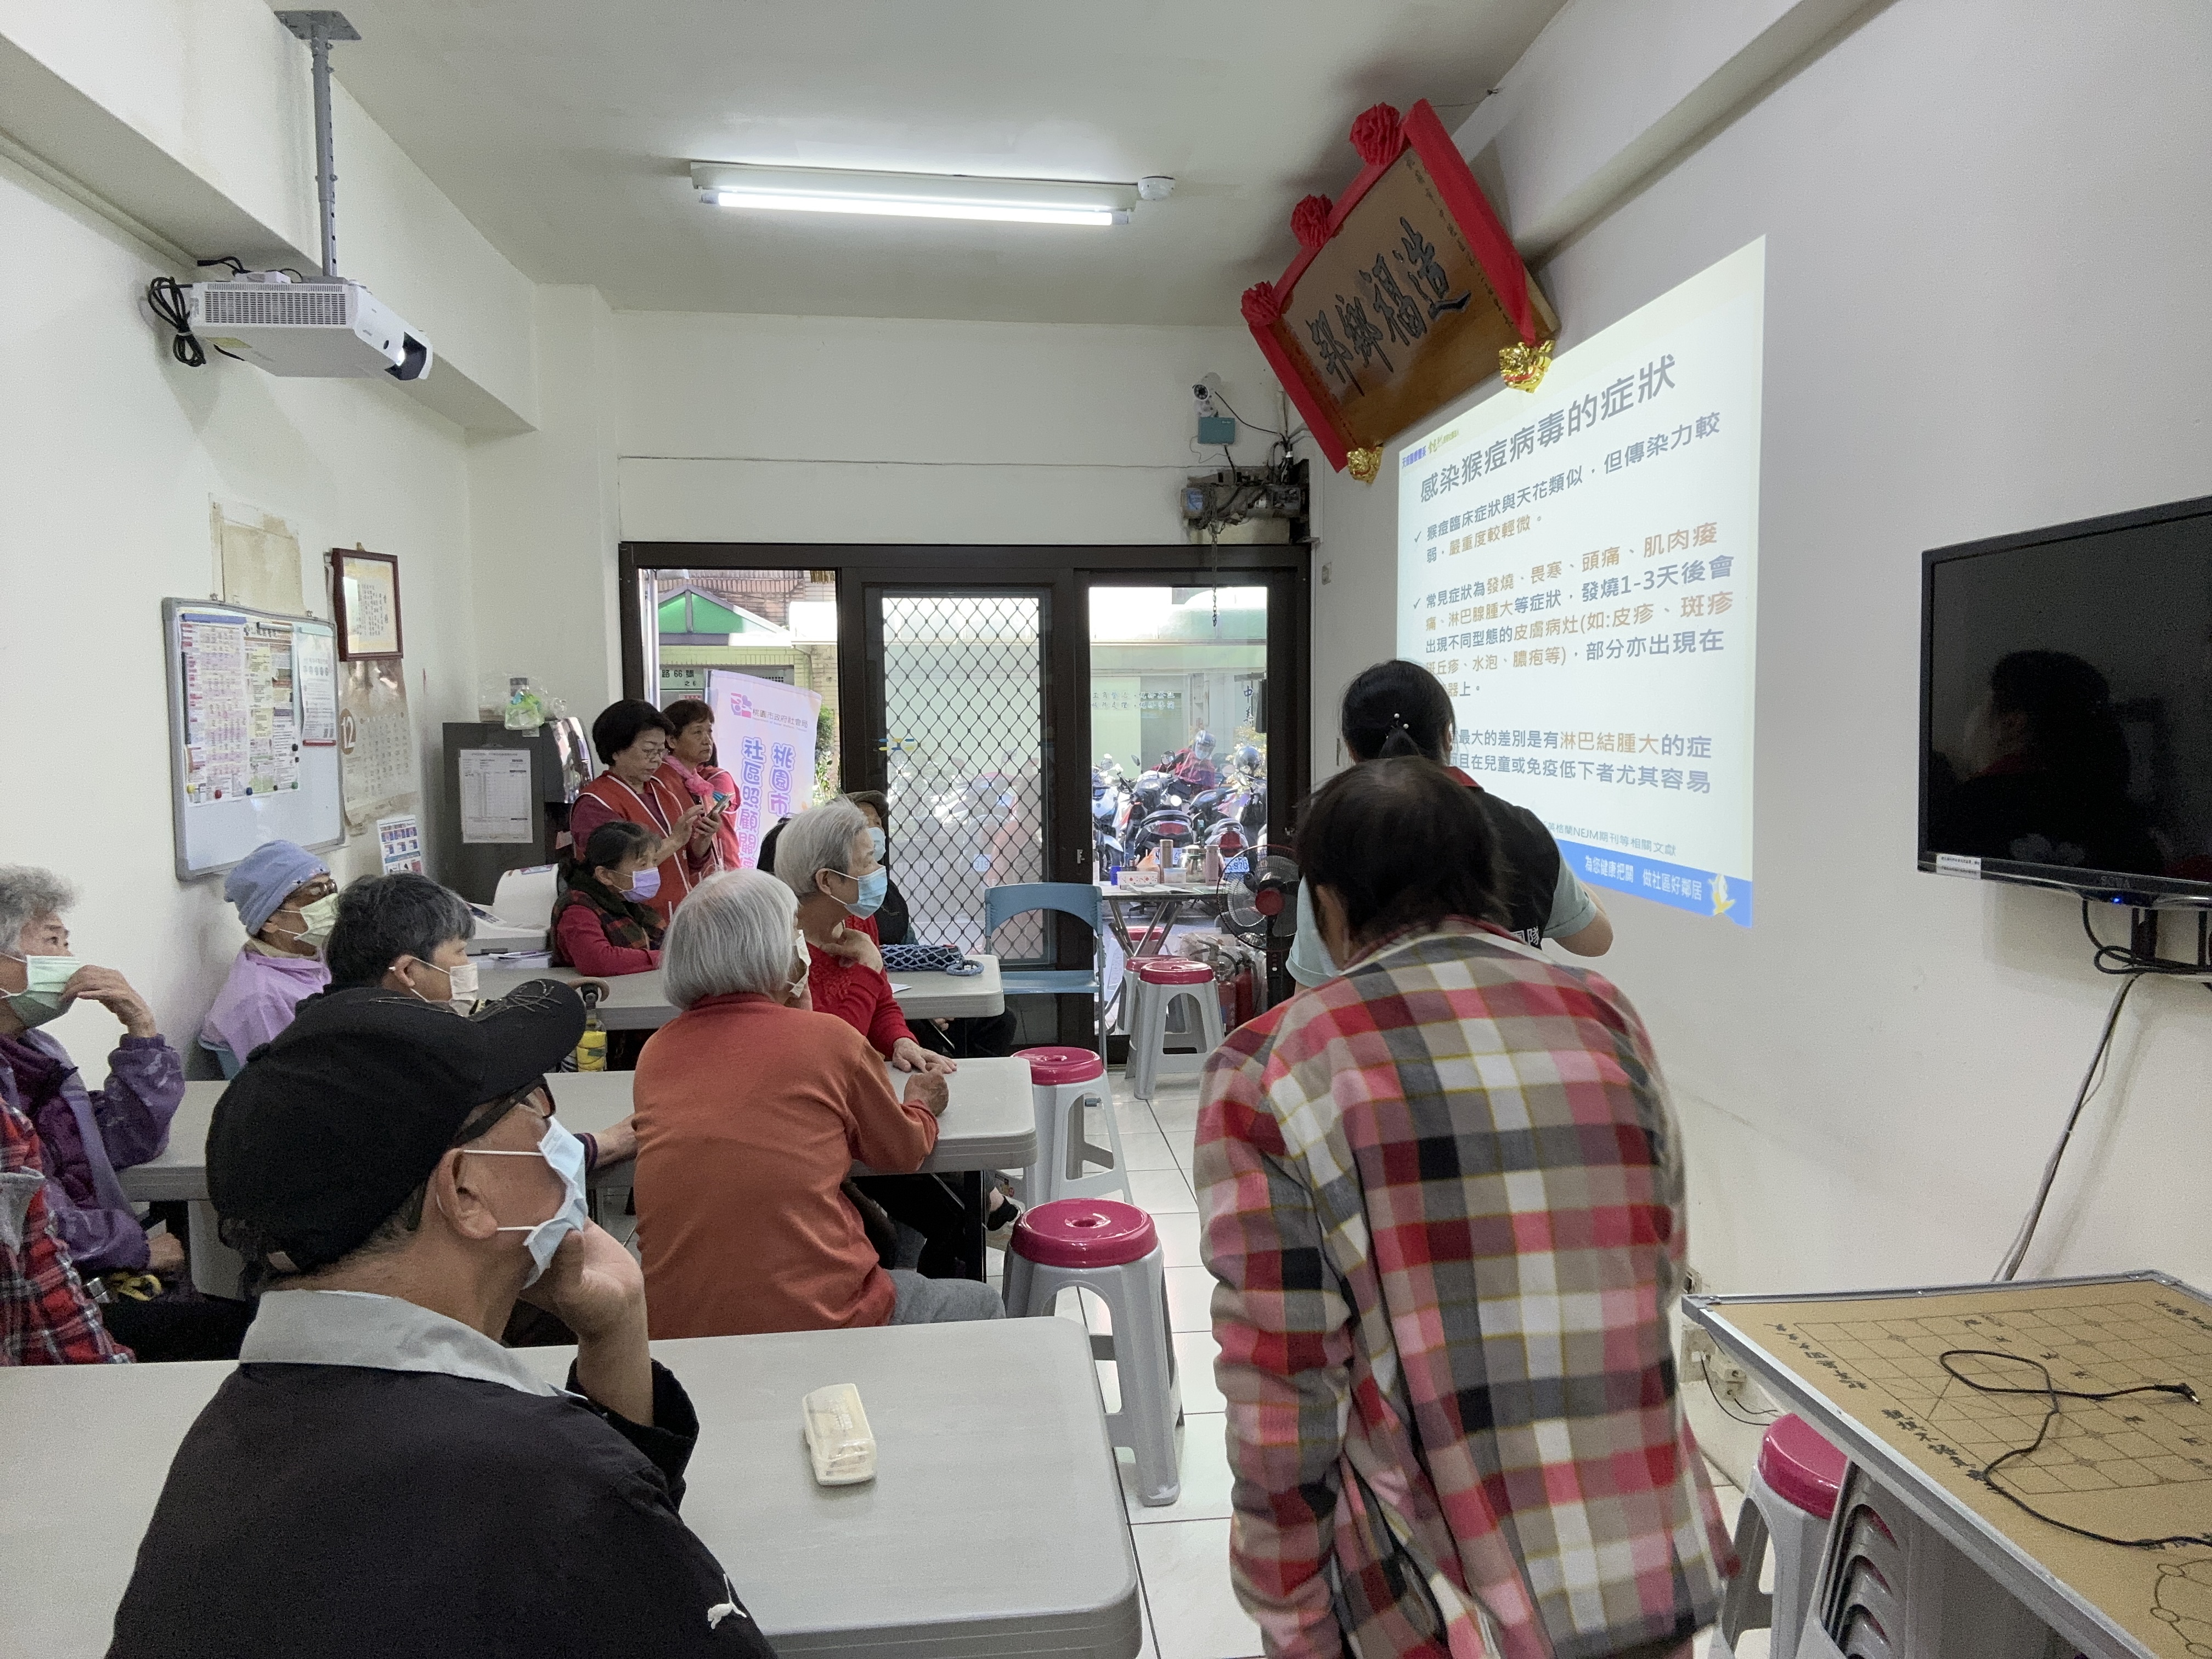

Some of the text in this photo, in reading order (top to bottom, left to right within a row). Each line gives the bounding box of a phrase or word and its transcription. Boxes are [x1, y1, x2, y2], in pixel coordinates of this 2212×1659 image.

[1420, 353, 1676, 503] 感染猴痘病毒的症狀
[674, 669, 682, 678] 66
[1444, 681, 1480, 697] 器上。
[341, 716, 356, 749] 12
[752, 708, 808, 729] 桃園市政府社會局
[1453, 729, 1712, 759] 最大的差別是有淋巴結腫大的症
[770, 743, 795, 816] 桃園市
[1544, 821, 1677, 856] 英格蘭NEJM期刊等相關文獻
